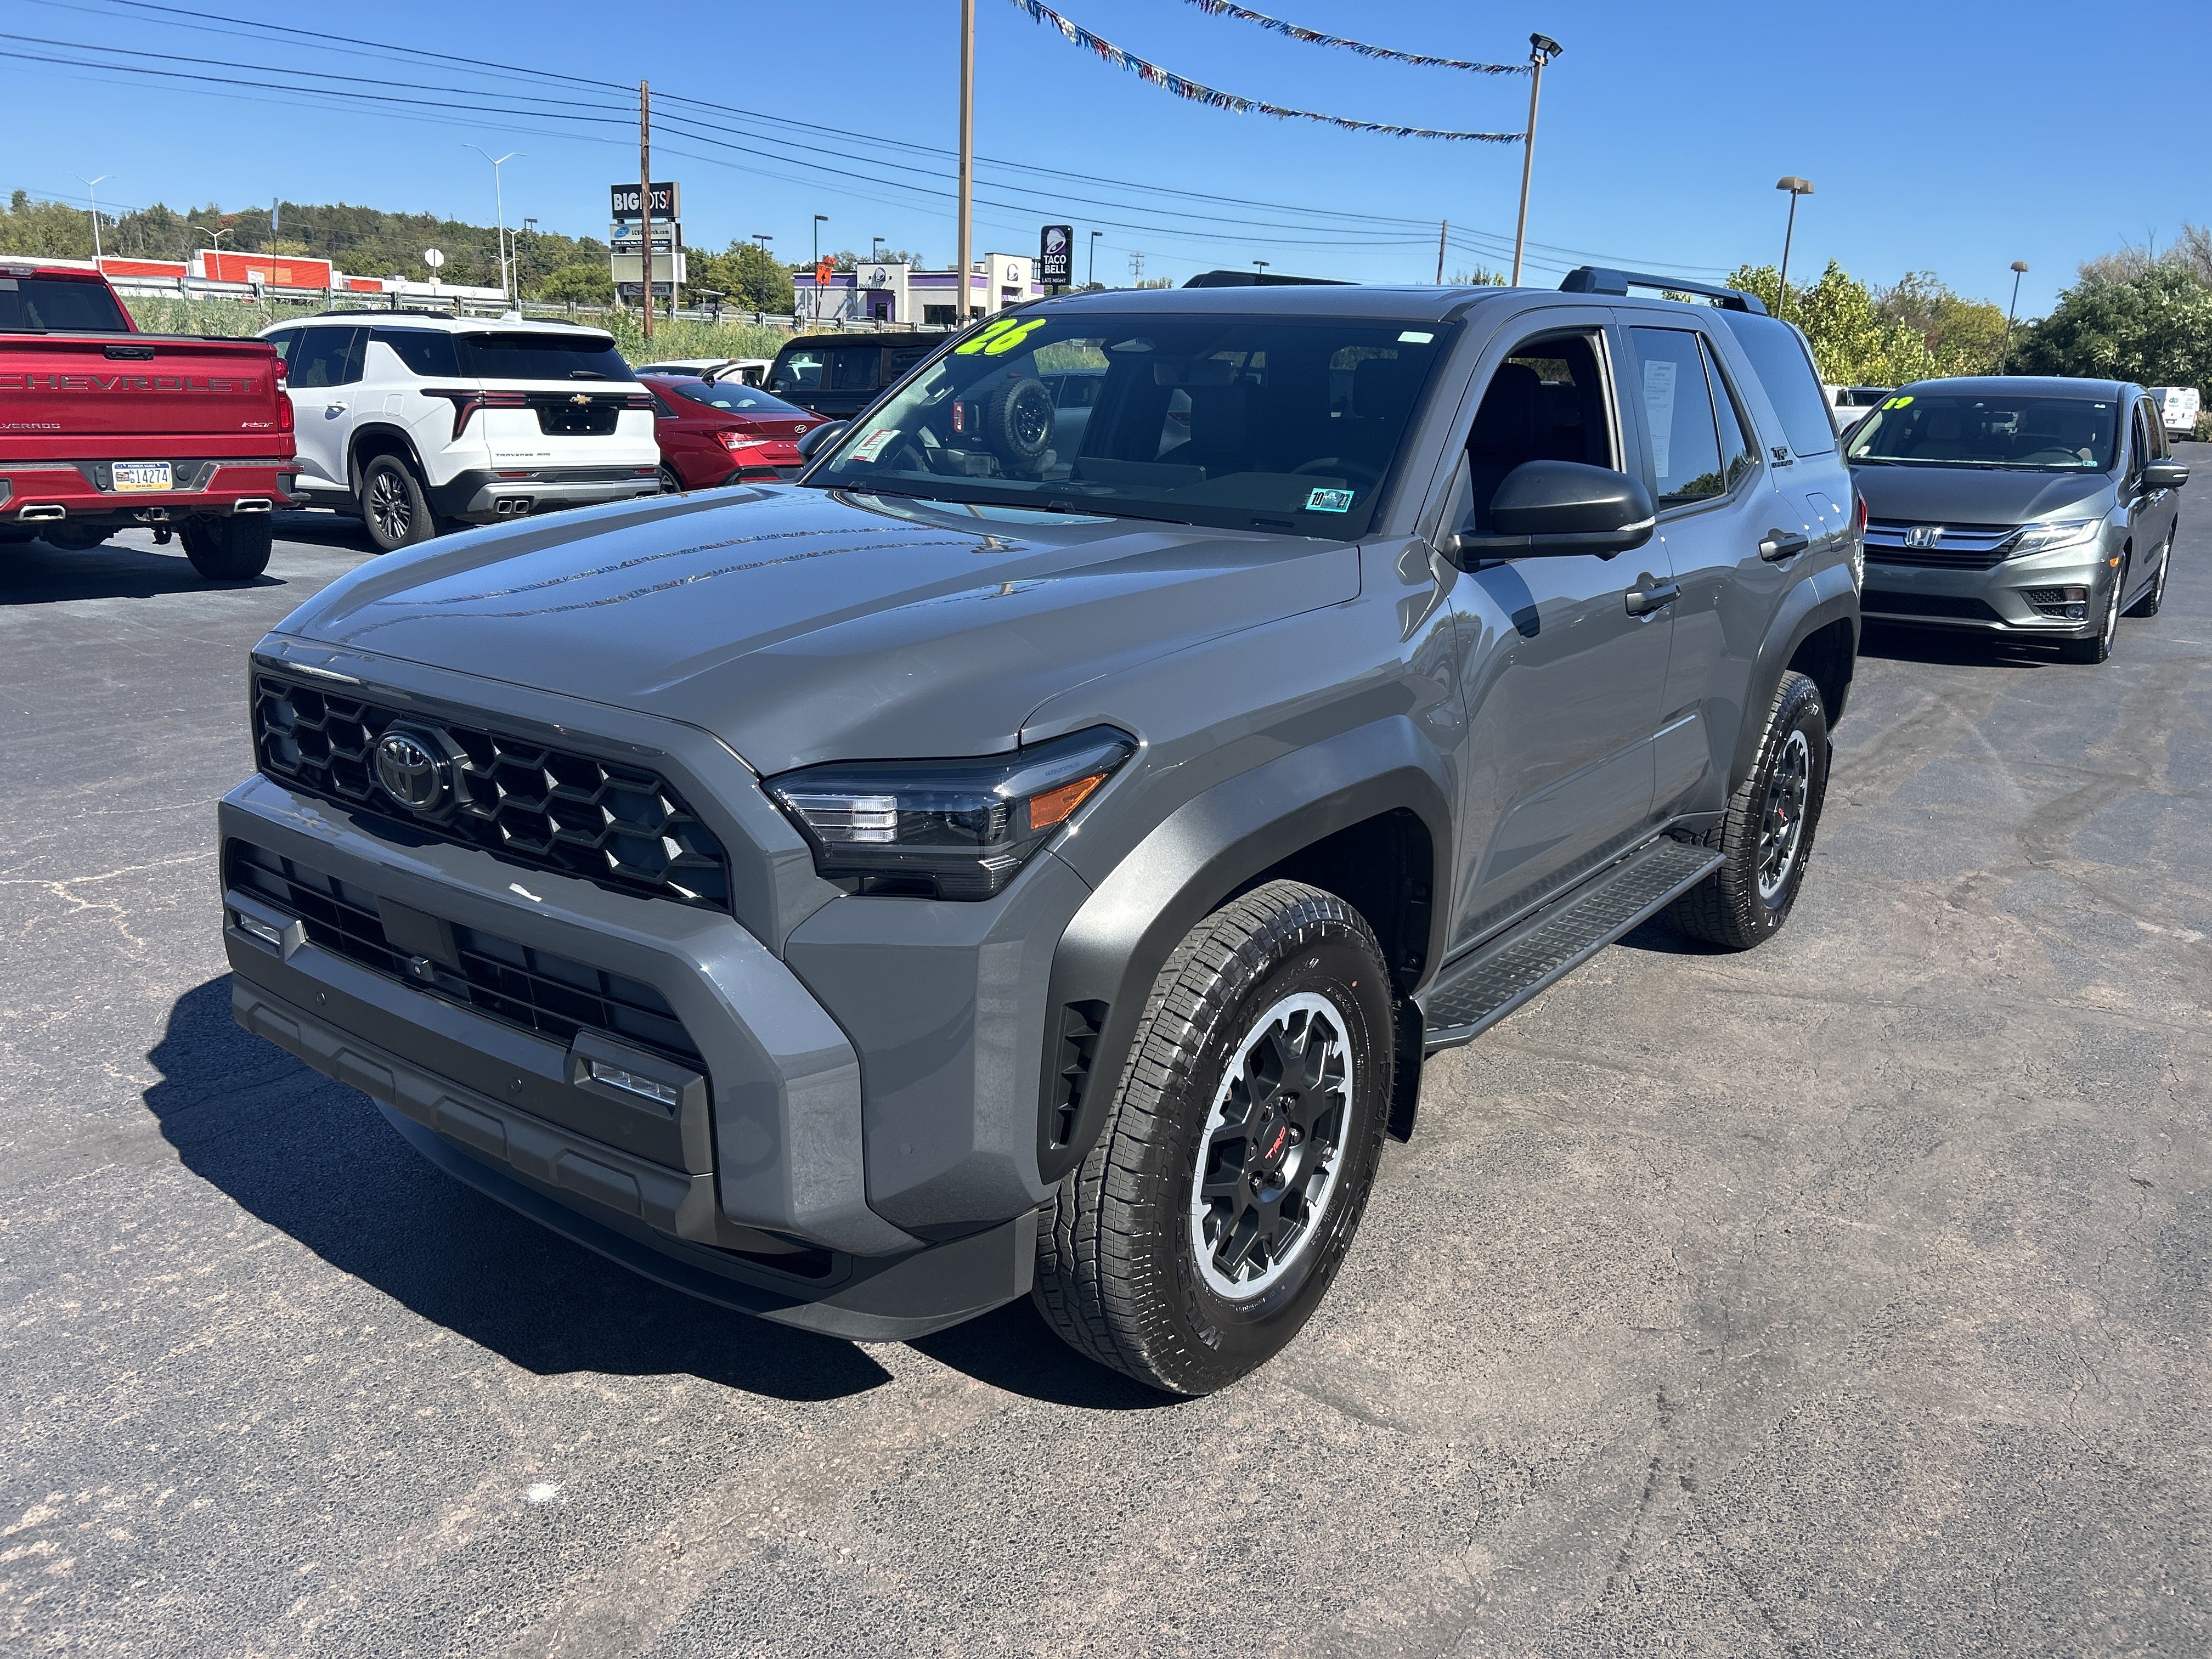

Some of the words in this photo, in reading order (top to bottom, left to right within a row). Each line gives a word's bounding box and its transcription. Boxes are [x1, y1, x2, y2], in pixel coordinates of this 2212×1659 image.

[613, 193, 639, 211] BIG
[1043, 255, 1066, 264] TACO
[1045, 264, 1066, 274] BELL
[955, 318, 1046, 355] 26
[0, 374, 257, 392] CHEVROLET
[1881, 396, 1914, 410] 19
[136, 469, 168, 483] 14274
[1311, 492, 1325, 506] 10
[1336, 493, 1350, 508] 27
[1265, 1126, 1286, 1159] TRD
